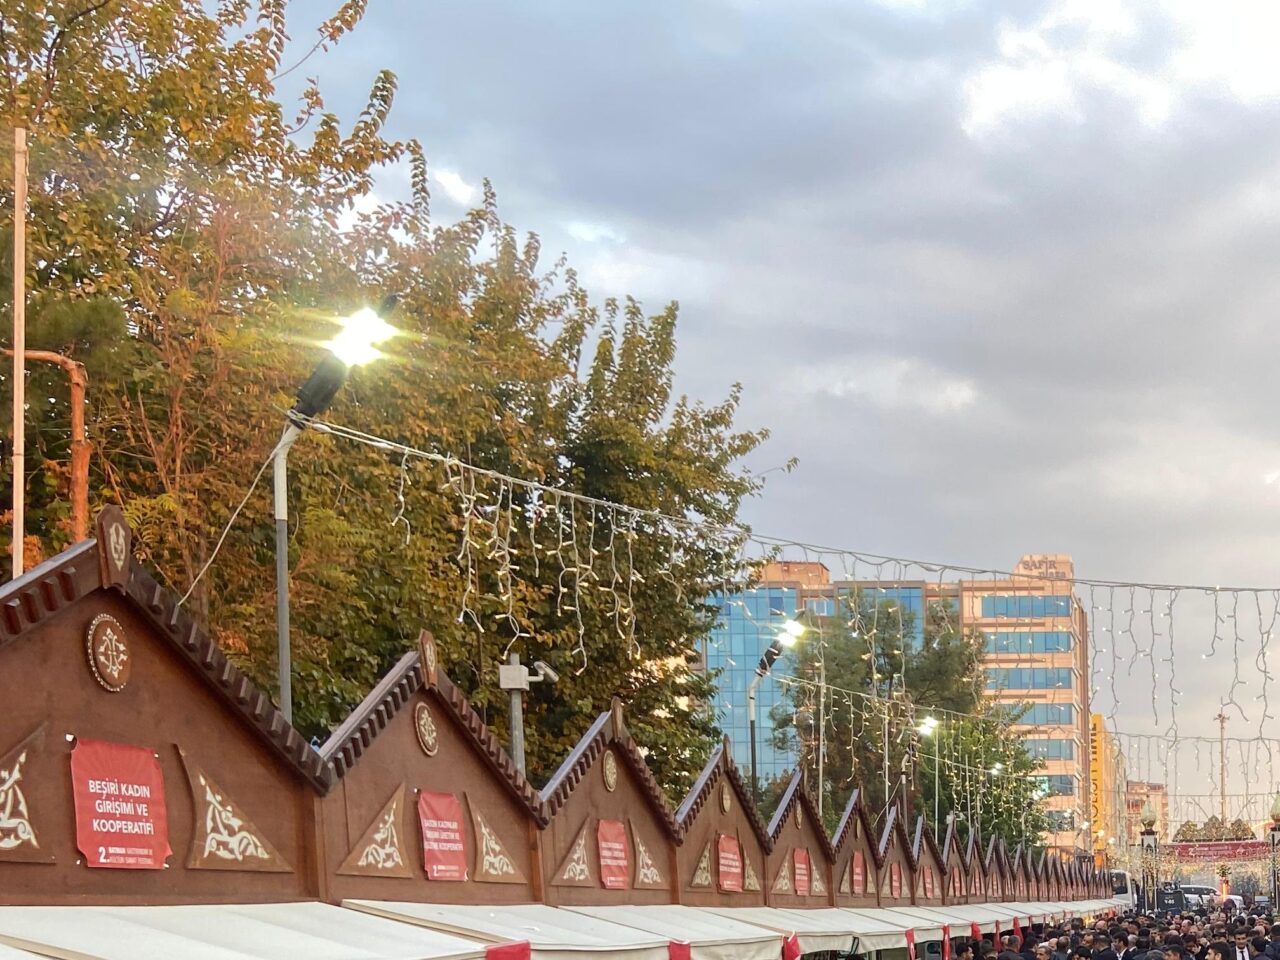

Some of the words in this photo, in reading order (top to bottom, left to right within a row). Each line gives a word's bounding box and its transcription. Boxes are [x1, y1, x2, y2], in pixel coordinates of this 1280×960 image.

[88, 777, 119, 799] BEŞİRİ
[120, 783, 151, 798] KADIN
[95, 797, 135, 817] GİRİŞİMİ
[136, 804, 149, 817] VE
[92, 818, 154, 835] KOOPERATİFİ
